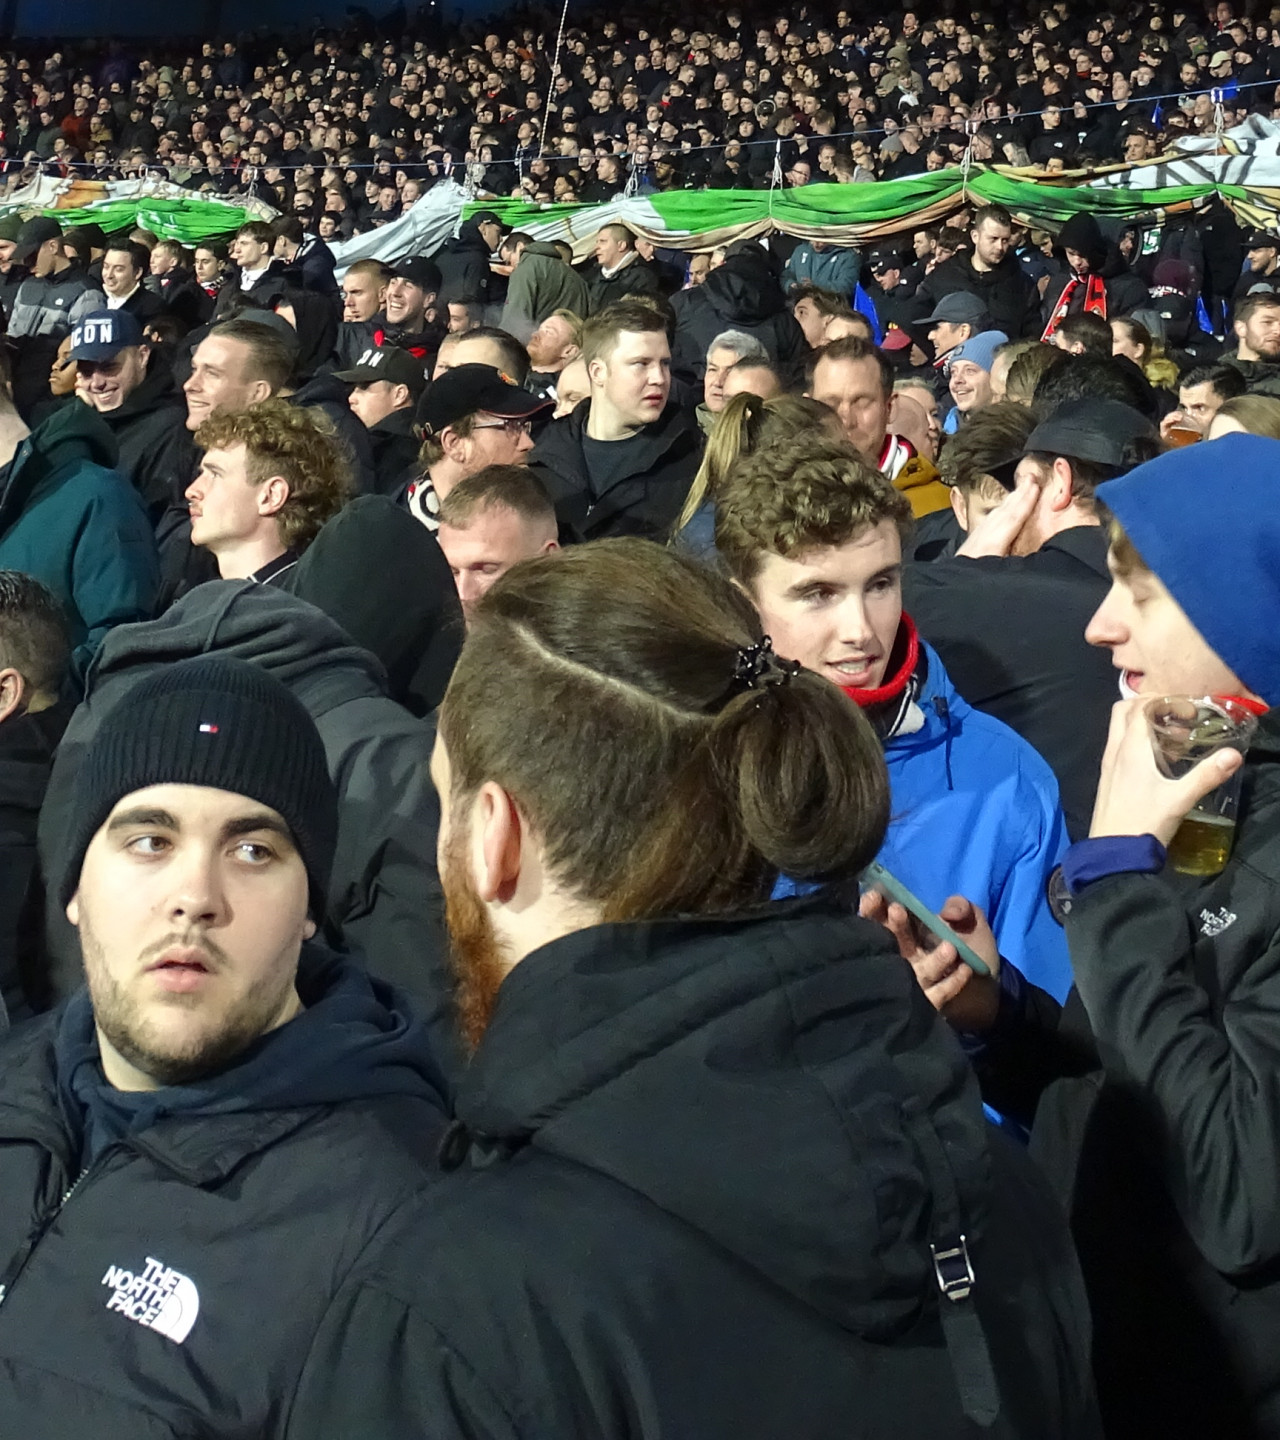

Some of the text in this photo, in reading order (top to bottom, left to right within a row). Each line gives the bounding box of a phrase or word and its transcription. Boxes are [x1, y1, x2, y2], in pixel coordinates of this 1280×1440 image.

[101, 1265, 172, 1311] NORTH
[141, 1256, 181, 1293] THE
[105, 1289, 161, 1327] FACE
